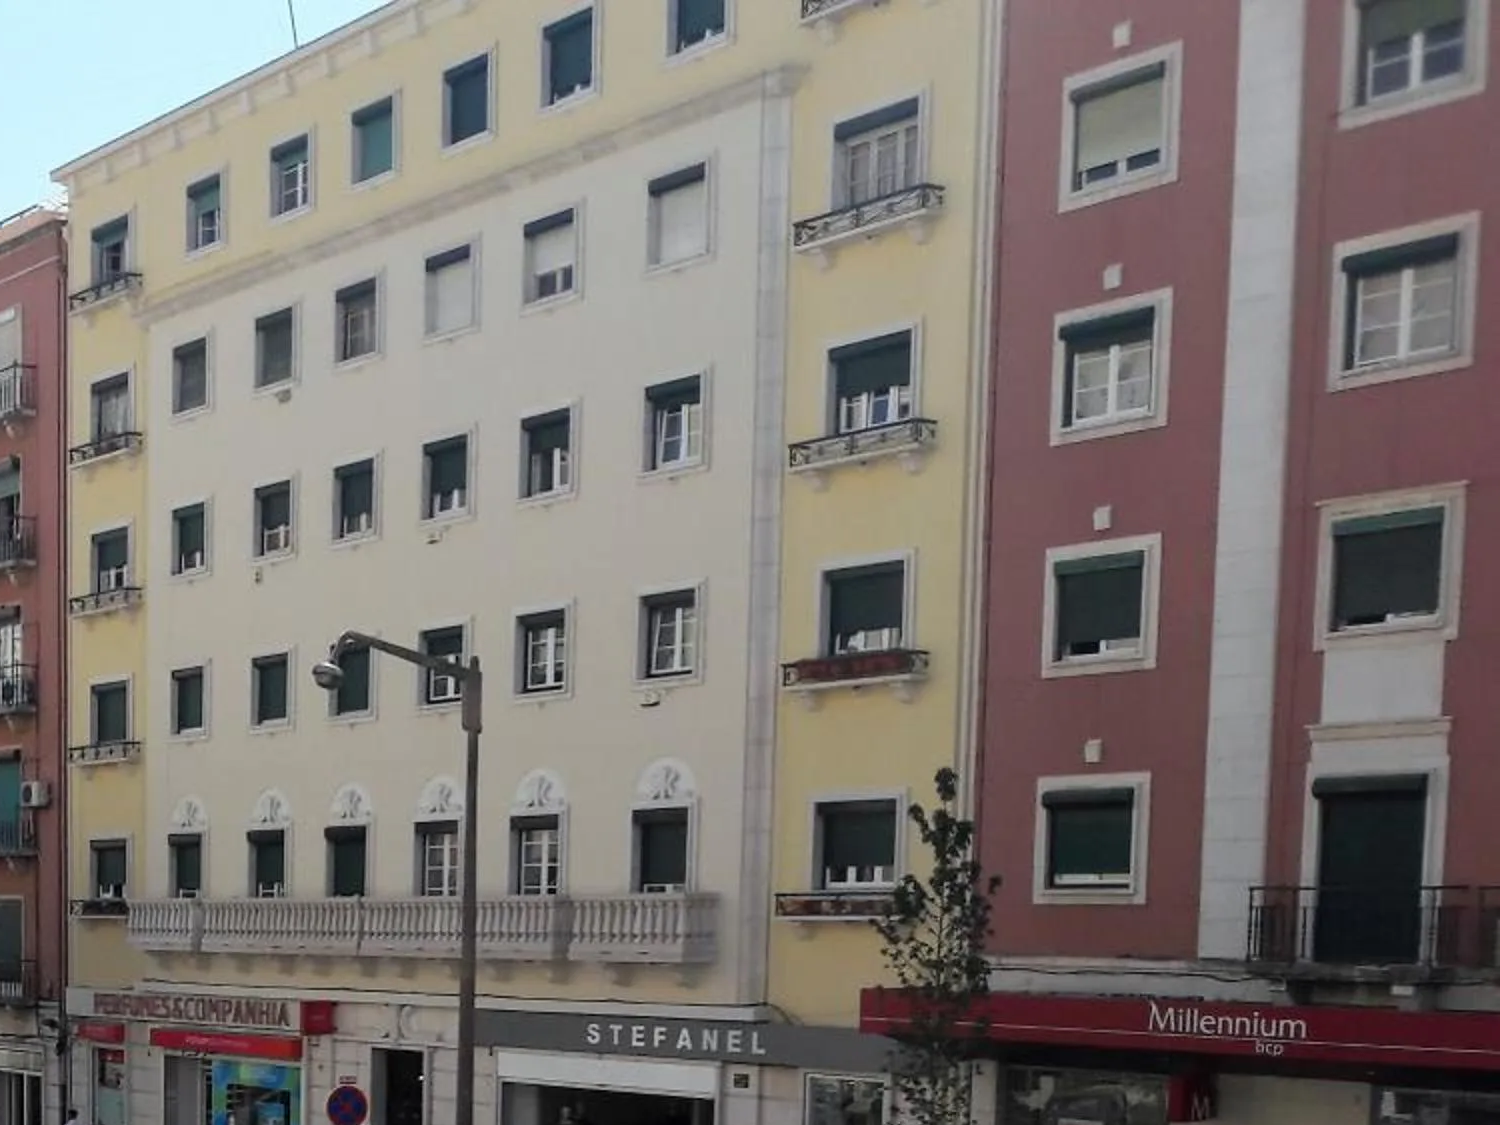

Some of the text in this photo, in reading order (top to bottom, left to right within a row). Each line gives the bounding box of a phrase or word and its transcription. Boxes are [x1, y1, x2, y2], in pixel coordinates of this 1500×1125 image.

[1149, 1000, 1307, 1038] Millennium
[586, 1023, 766, 1054] STEFANEL
[1255, 1037, 1284, 1056] bcp
[1191, 1092, 1210, 1121] M
